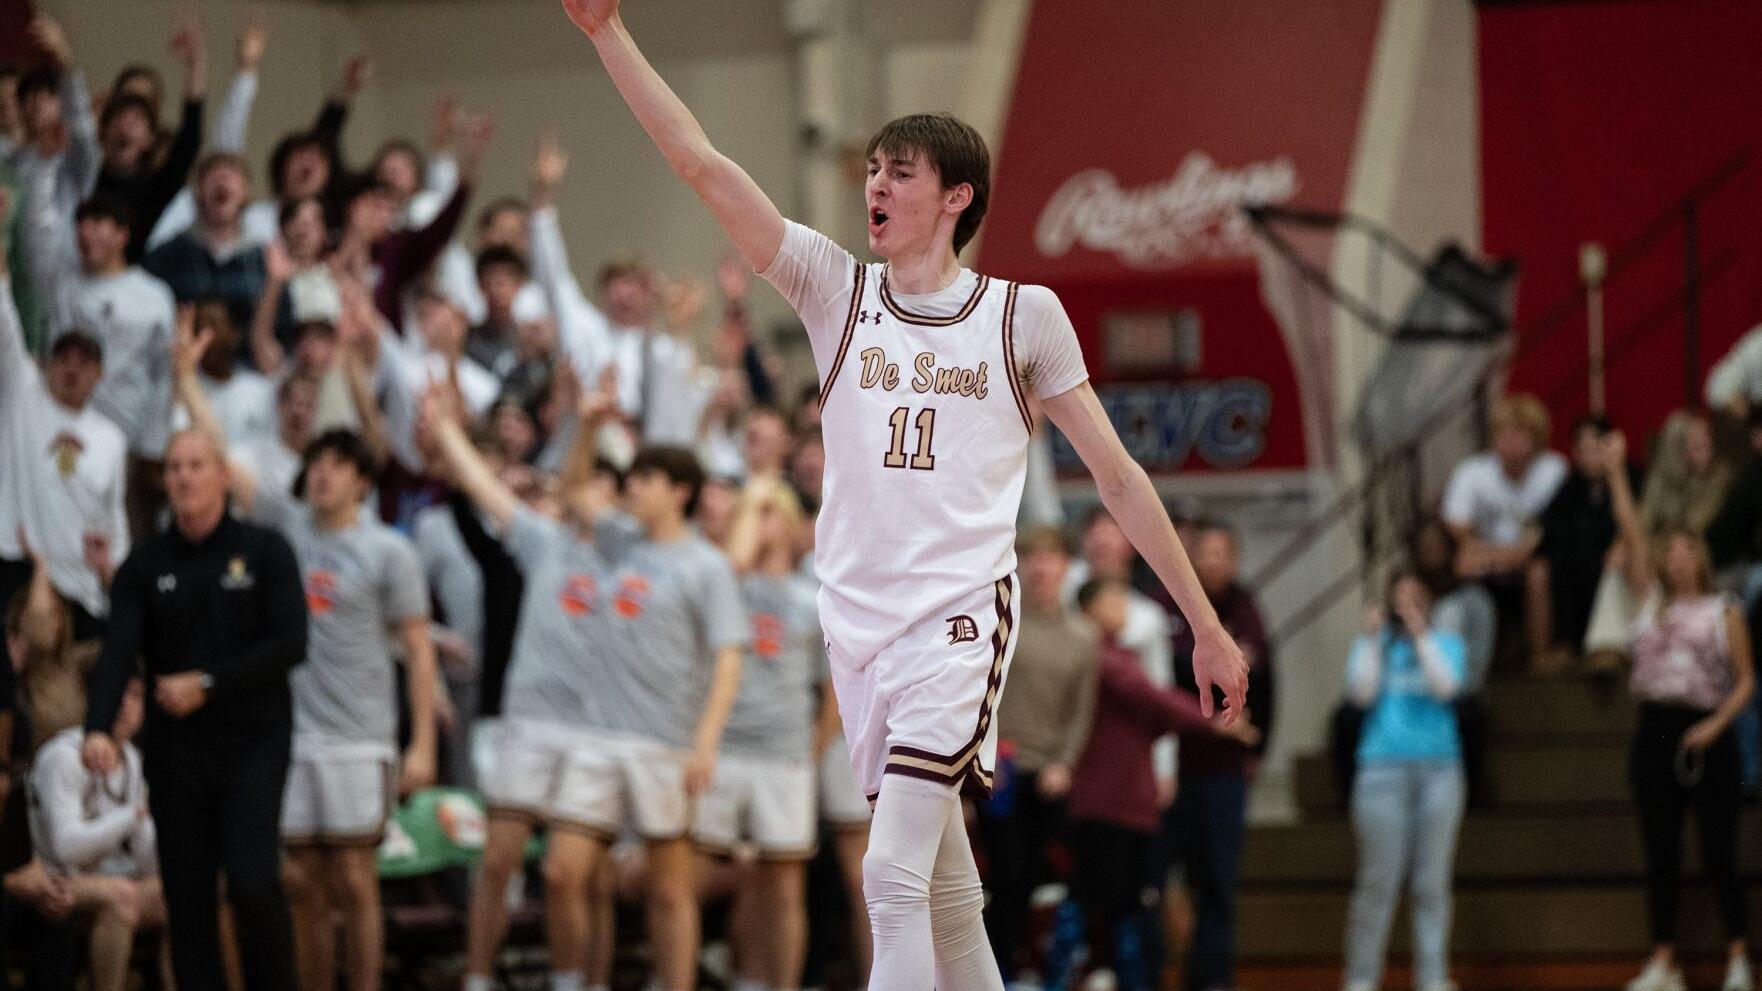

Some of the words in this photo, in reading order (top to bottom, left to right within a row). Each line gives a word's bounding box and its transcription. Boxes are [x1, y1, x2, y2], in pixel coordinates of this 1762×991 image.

[860, 347, 899, 391] De
[912, 352, 988, 400] Smet
[884, 407, 936, 470] 11
[946, 615, 979, 646] D
